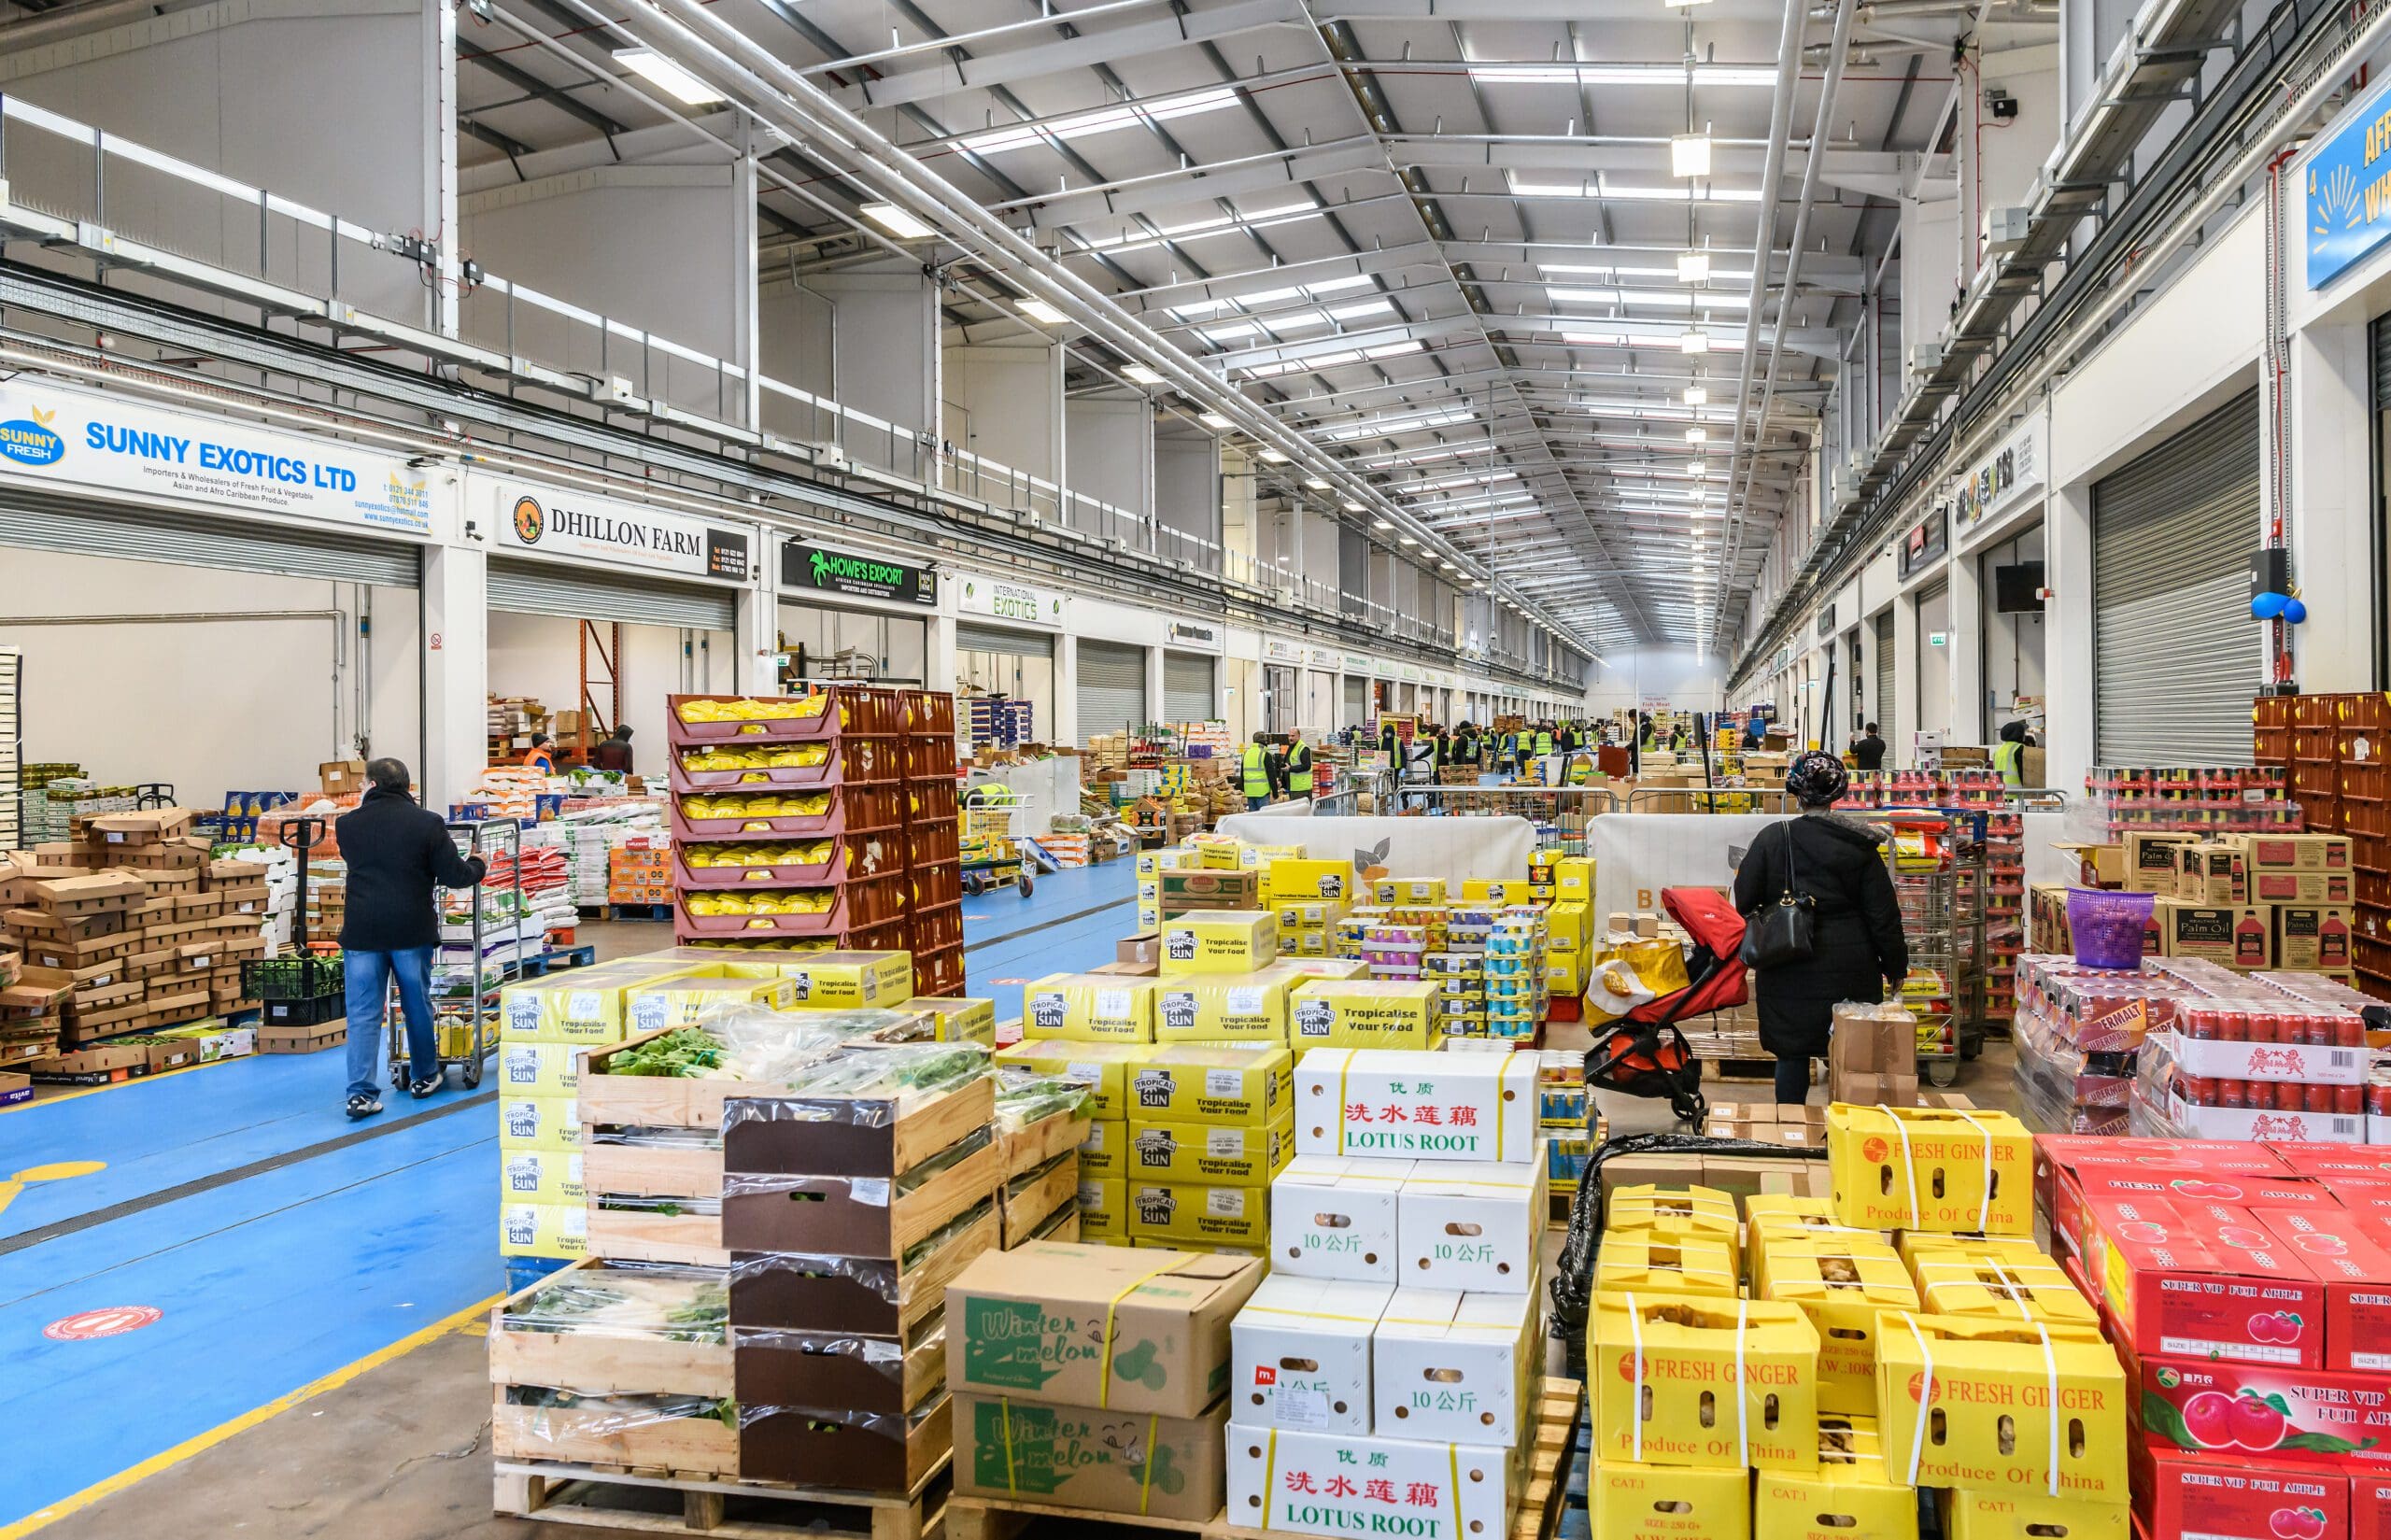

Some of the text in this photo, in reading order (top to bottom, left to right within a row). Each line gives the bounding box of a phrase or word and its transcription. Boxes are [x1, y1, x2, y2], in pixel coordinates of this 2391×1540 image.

[2309, 168, 2317, 197] 4
[0, 427, 57, 449] SUNNY
[7, 443, 51, 459] FRESH
[86, 421, 356, 492] SUNNY EXOTICS LTD
[143, 465, 178, 479] Importers
[188, 473, 231, 487] Wholesalers
[233, 479, 240, 487] of
[241, 482, 260, 492] Fresh
[261, 485, 276, 495] Fruit
[284, 488, 314, 502] Vegetable
[389, 484, 402, 494] 0121
[173, 480, 290, 506] Asian and Afro Caribbean Produce.
[552, 508, 646, 548] DHILLON
[652, 527, 700, 557] FARM
[829, 557, 903, 586] HOWE'S EXPORT
[993, 584, 1037, 601] INTERNATIONAL
[994, 596, 1038, 620] EXOTICS
[2142, 851, 2162, 860] Palm
[2181, 922, 2229, 934] Palm Oil
[2287, 921, 2305, 929] Palm
[1167, 937, 1198, 948] TROPICAL
[1205, 939, 1248, 947] Tropicalise
[1171, 949, 1193, 959] SUN
[819, 980, 857, 988] Tropicalise
[821, 988, 855, 996] Your Food
[507, 1004, 543, 1015] TROPICAL
[632, 1004, 670, 1015] TROPICAL
[1161, 1001, 1198, 1011] TROPICAL
[1169, 1015, 1193, 1026] SUN
[1219, 1016, 1270, 1024] Tropicalise
[1295, 1009, 1335, 1021] TROPICAL
[1344, 1009, 1418, 1021] Tropicalise
[2101, 1003, 2142, 1032] ERMALT
[514, 1018, 536, 1028] SUN
[560, 1020, 607, 1028] Tropicalise
[640, 1018, 663, 1028] SUN
[1303, 1024, 1328, 1035] SUN
[1349, 1022, 1413, 1032] Your Food
[2087, 1030, 2130, 1052] SUPERMALT
[1136, 1079, 1176, 1093] TROPICAL
[1389, 1081, 1435, 1095] 优质
[1142, 1094, 1167, 1106] SUN
[1196, 1098, 1252, 1109] Tropicalise
[506, 1111, 540, 1123] TROPICAL
[1199, 1107, 1248, 1116] Your Food
[1345, 1103, 1478, 1128] 洗水莲藕
[512, 1125, 535, 1137] SUN
[1136, 1139, 1177, 1152] TROPICAL
[1347, 1131, 1480, 1152] LOTUS ROOT
[1893, 1141, 1945, 1160] FESH
[1142, 1153, 1167, 1166] SUN
[1197, 1158, 1252, 1169] Tropicalise
[1225, 1167, 1250, 1177] Food
[2108, 1180, 2317, 1202] FRESH APPLE
[1939, 1208, 1959, 1222] Of
[1304, 1233, 1364, 1253] 10 公斤
[1435, 1243, 1495, 1264] 10 公斤
[2161, 1279, 2303, 1301] SUPER VIP FUJI APPLE
[2350, 1293, 2391, 1306] SUPER
[982, 1308, 1078, 1339] Winter
[1016, 1335, 1099, 1364] melon
[2357, 1357, 2378, 1365] SIZE
[1654, 1358, 1799, 1386] FRESH GNGER
[1411, 1390, 1478, 1413] 10 公斤
[1947, 1379, 2105, 1411] FRESH GIGER
[2290, 1385, 2385, 1406] SUPER VIP
[2317, 1406, 2358, 1424] FUJI
[992, 1413, 1092, 1446] Winter
[1620, 1433, 1697, 1454] Poduce
[1707, 1440, 1733, 1456] Of
[1027, 1440, 1114, 1469] melon
[1337, 1448, 1389, 1468] 优质
[2008, 1466, 2034, 1484] Of
[1285, 1470, 1439, 1508] 洗水莲藕
[1611, 1477, 1645, 1491] CAT.1
[2181, 1473, 2326, 1497] SUPER VIP FUJI APPLE
[1287, 1504, 1441, 1539] LOTUS ROOT
